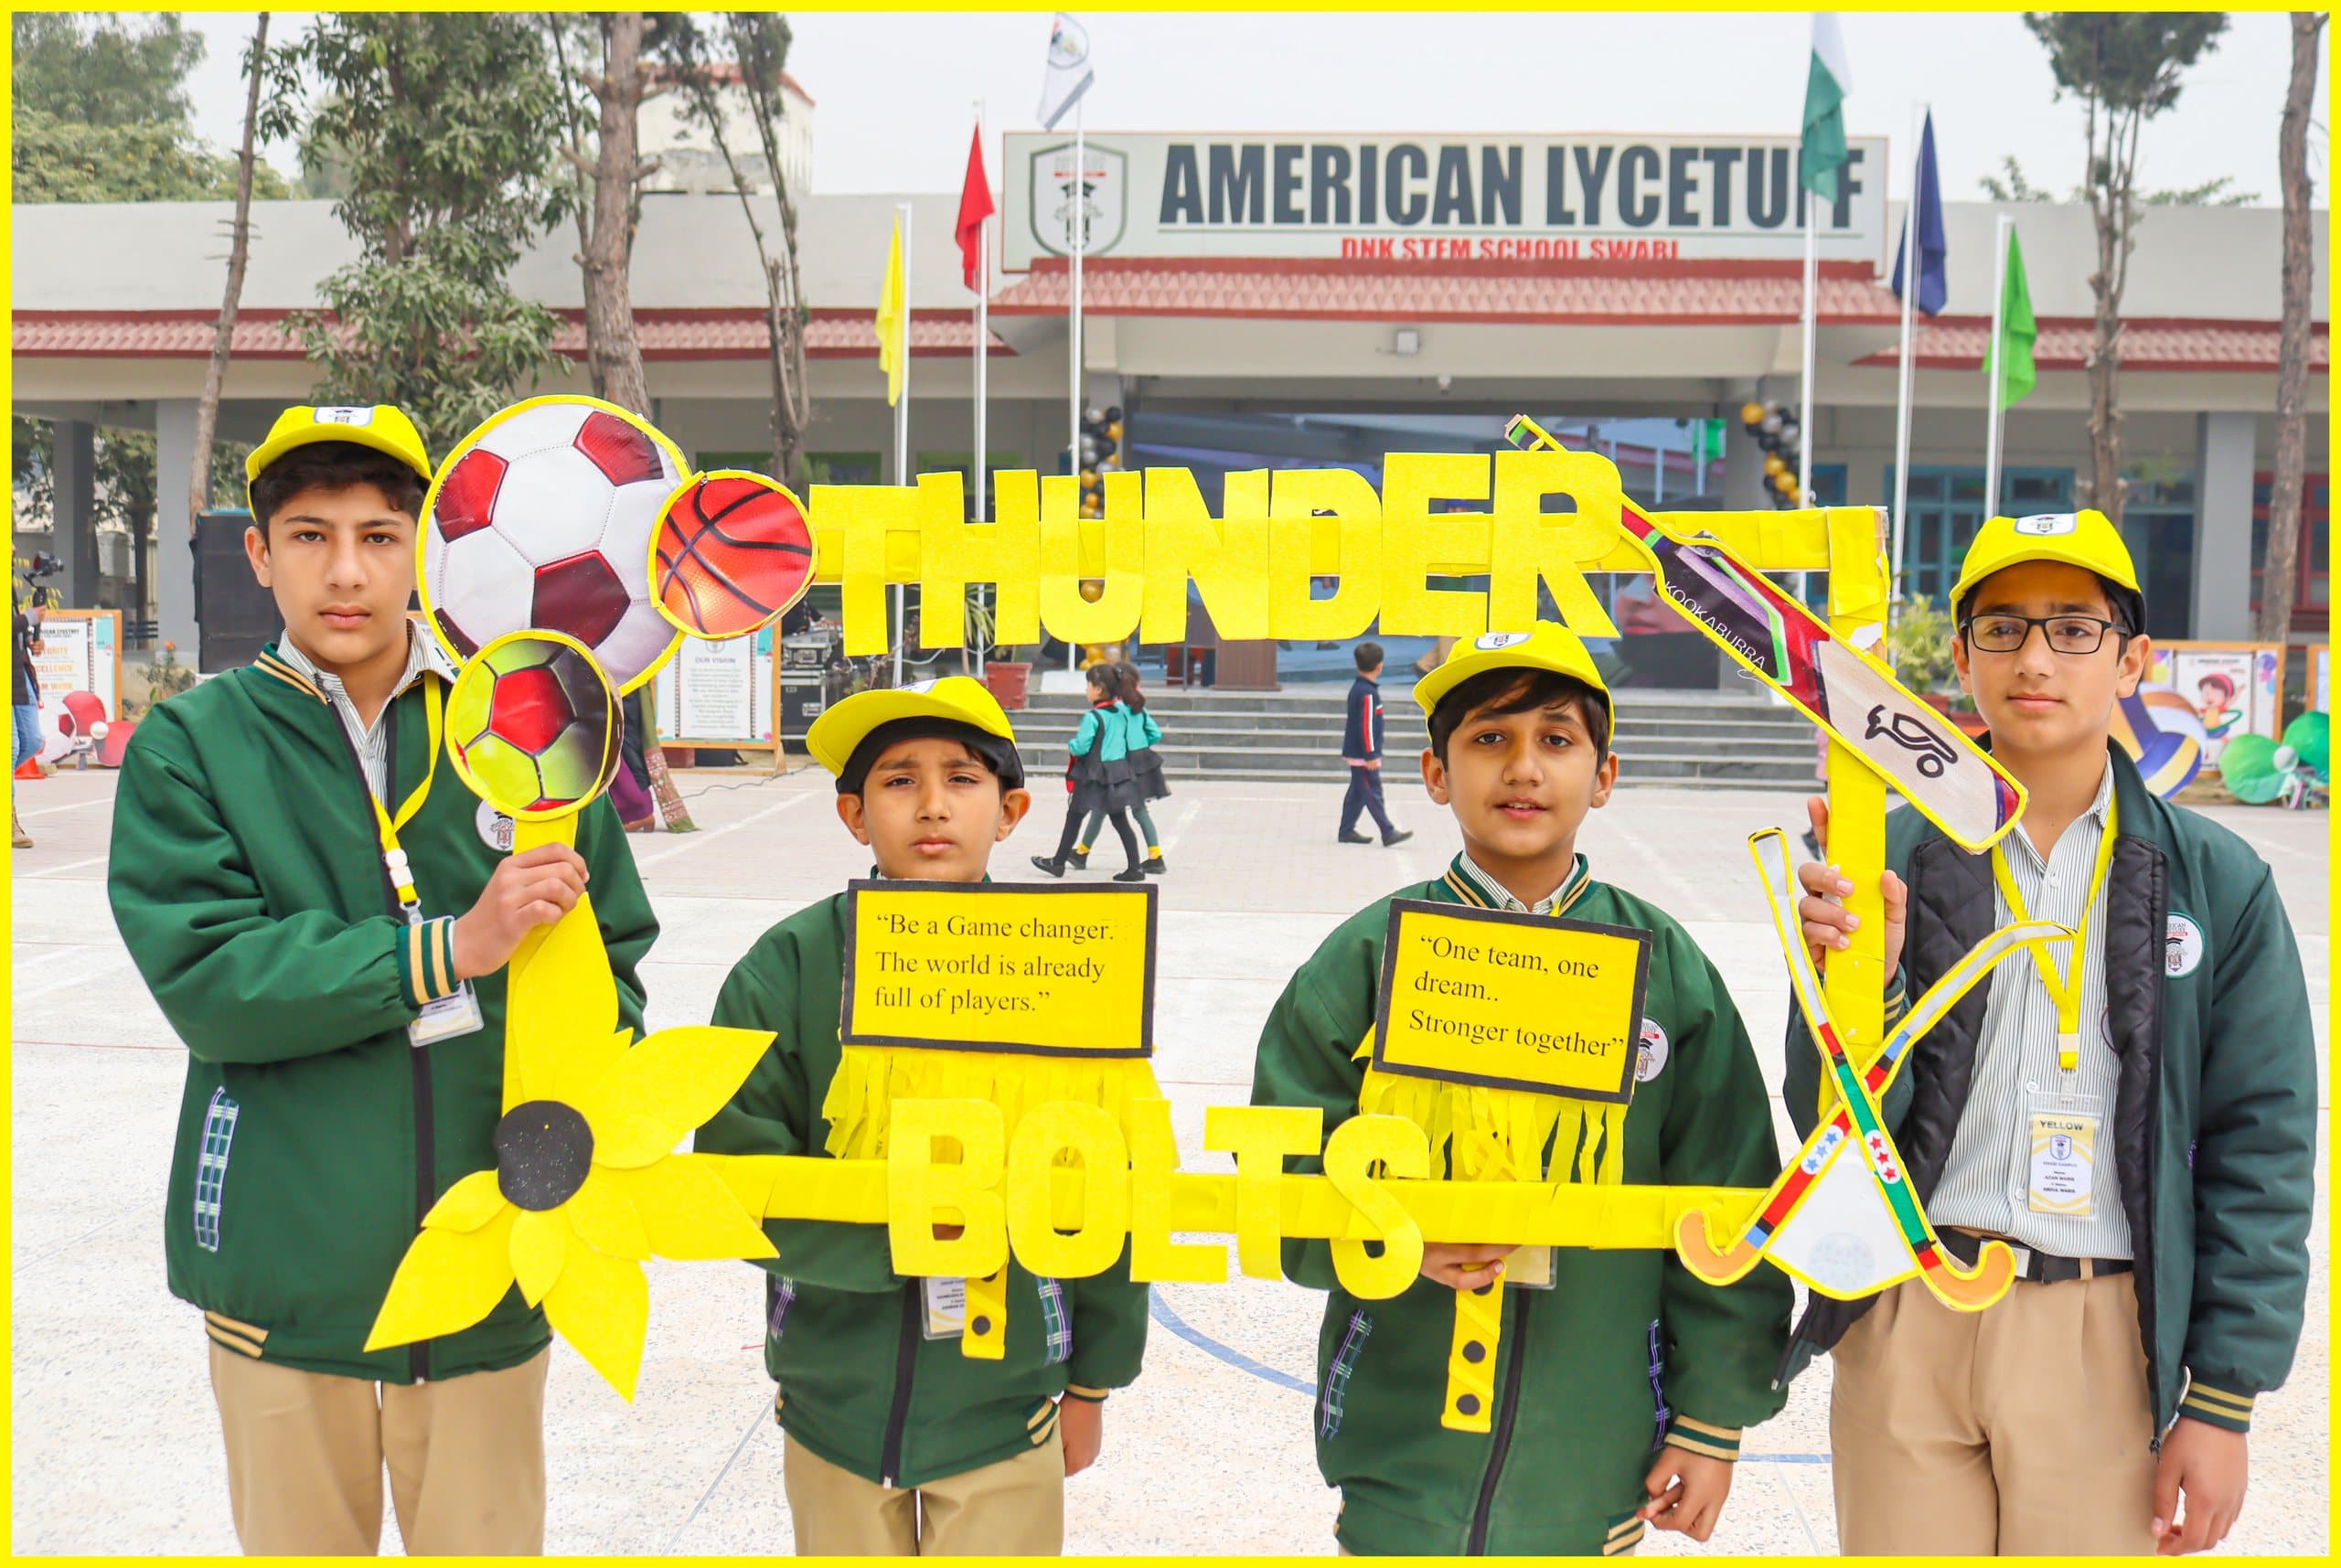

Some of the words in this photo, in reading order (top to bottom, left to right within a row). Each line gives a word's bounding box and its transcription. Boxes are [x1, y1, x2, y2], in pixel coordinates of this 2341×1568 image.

[1159, 143, 1523, 227] AMERICAN
[1402, 238, 1471, 259] STEM
[808, 449, 1622, 656] THUNDER
[1665, 581, 1766, 669] KOOKABURRA
[877, 914, 920, 935] “Be
[926, 920, 939, 935] a
[947, 915, 1012, 938] Game
[1020, 918, 1114, 945] changer.
[875, 952, 918, 974] The
[926, 955, 990, 976] world
[999, 955, 1016, 976] is
[1023, 956, 1106, 984] already
[1420, 934, 1480, 963] “One
[1488, 946, 1549, 975] team,
[1557, 959, 1599, 979] one
[874, 987, 912, 1008] full
[920, 987, 946, 1008] of
[951, 988, 1051, 1016] players.”
[1414, 971, 1500, 1002] dream..
[1409, 1009, 1510, 1045] Stronger
[1516, 1027, 1625, 1058] together”
[2040, 1120, 2084, 1131] YELLOW
[888, 1099, 1432, 1300] BOLTS
